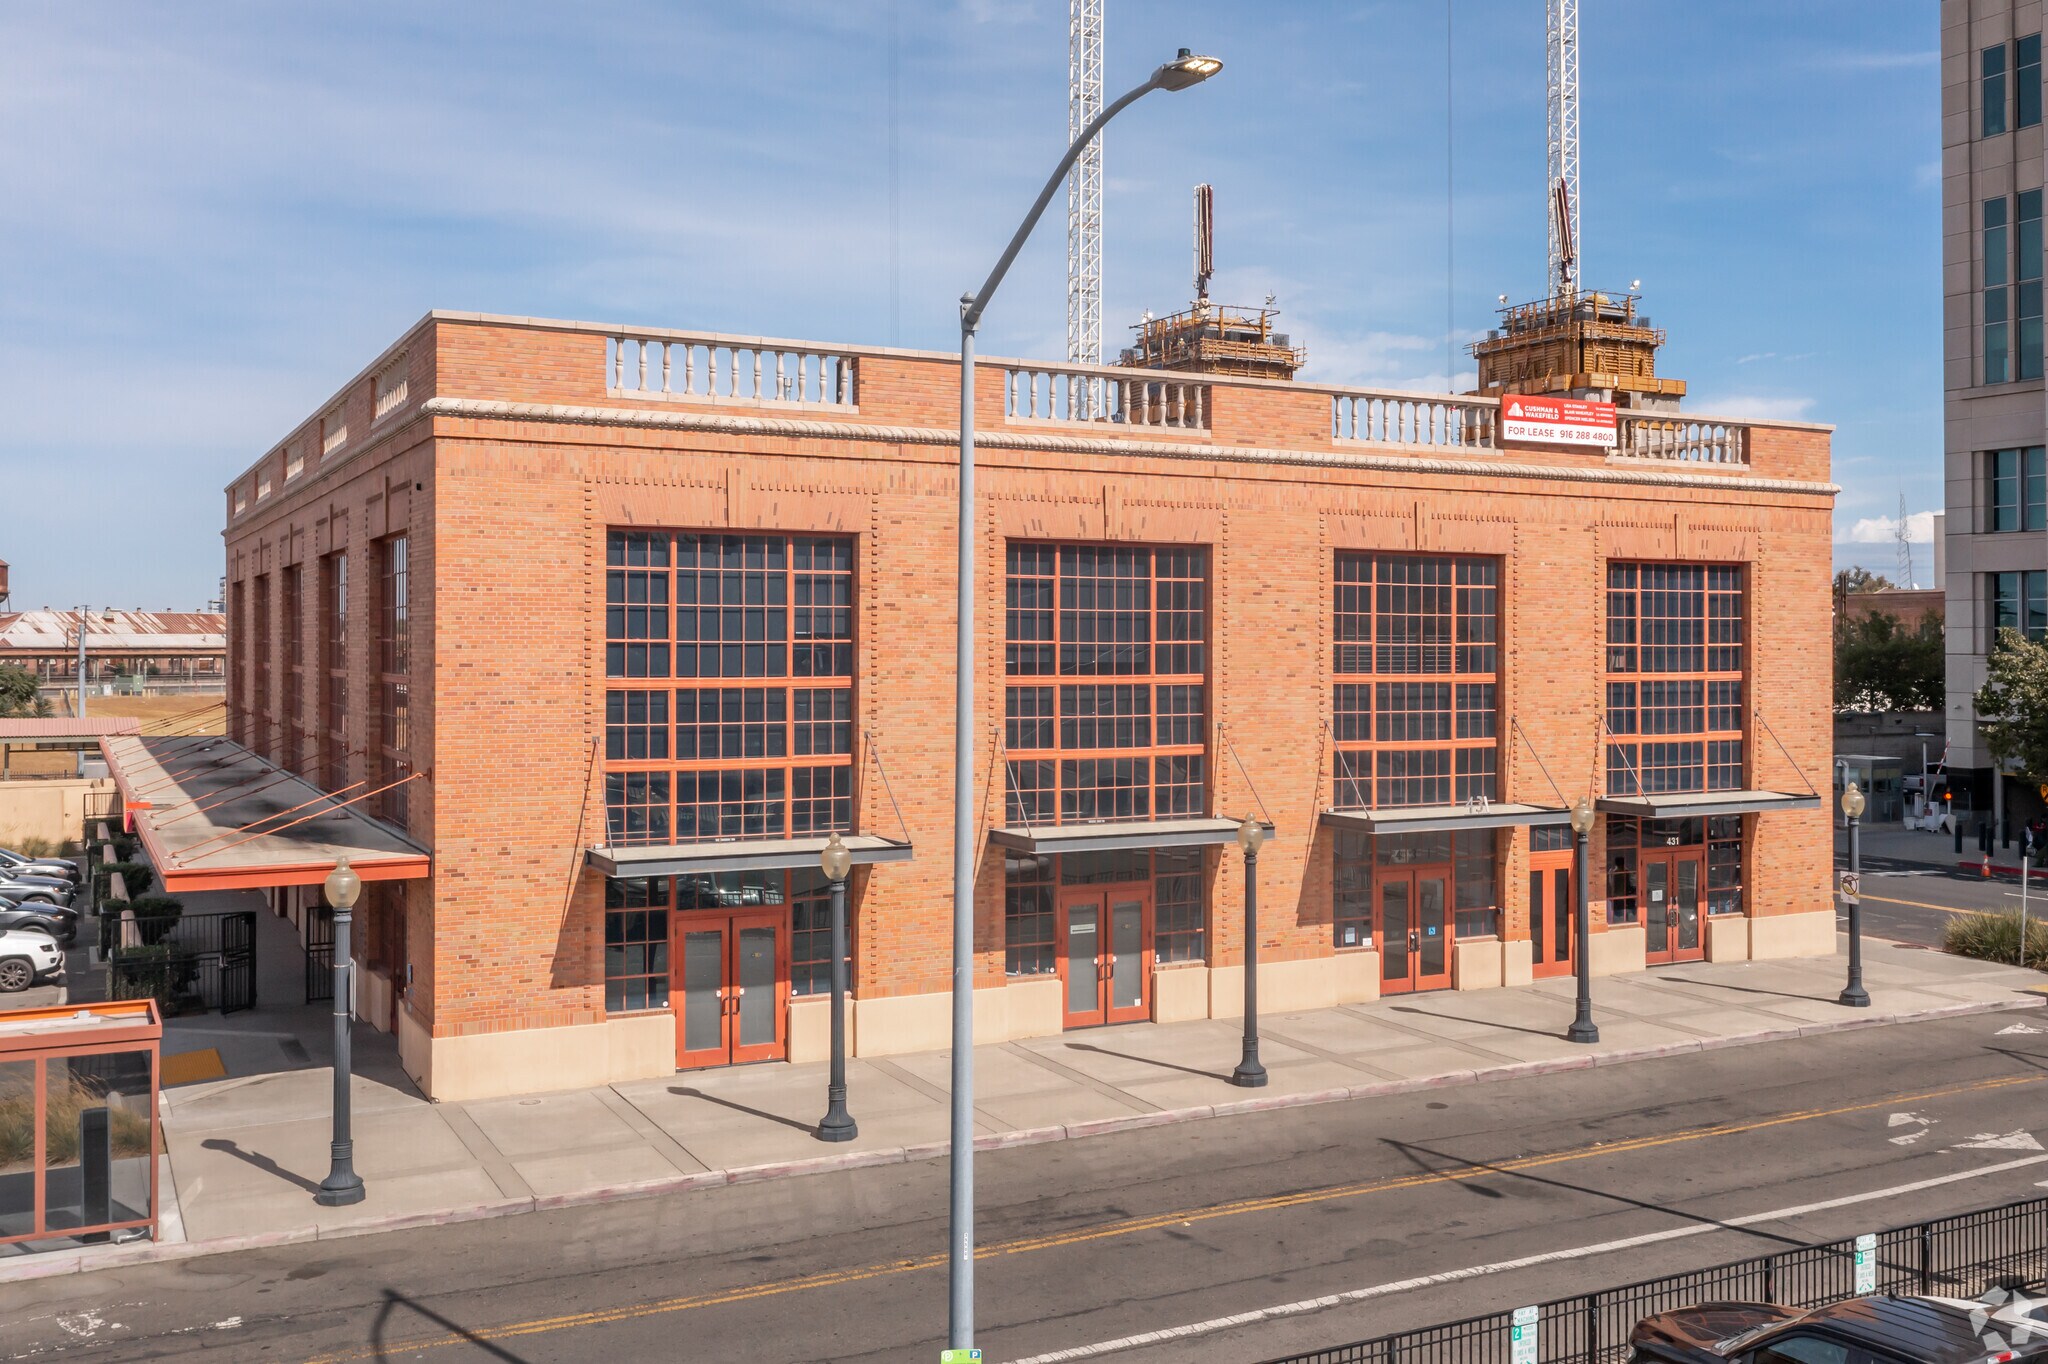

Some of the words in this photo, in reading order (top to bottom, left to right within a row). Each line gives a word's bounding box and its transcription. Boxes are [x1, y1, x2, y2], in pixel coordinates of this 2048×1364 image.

[1525, 412, 1559, 420] WAKEFIELD
[1508, 426, 1525, 435] FOR
[1528, 428, 1554, 437] LEASE
[1560, 430, 1573, 438] 916
[1576, 431, 1590, 440] 288
[1593, 433, 1613, 441] 4800
[1465, 796, 1490, 814] 431
[1666, 837, 1679, 845] 431
[1857, 1253, 1862, 1263] 2
[1514, 1328, 1520, 1339] 2
